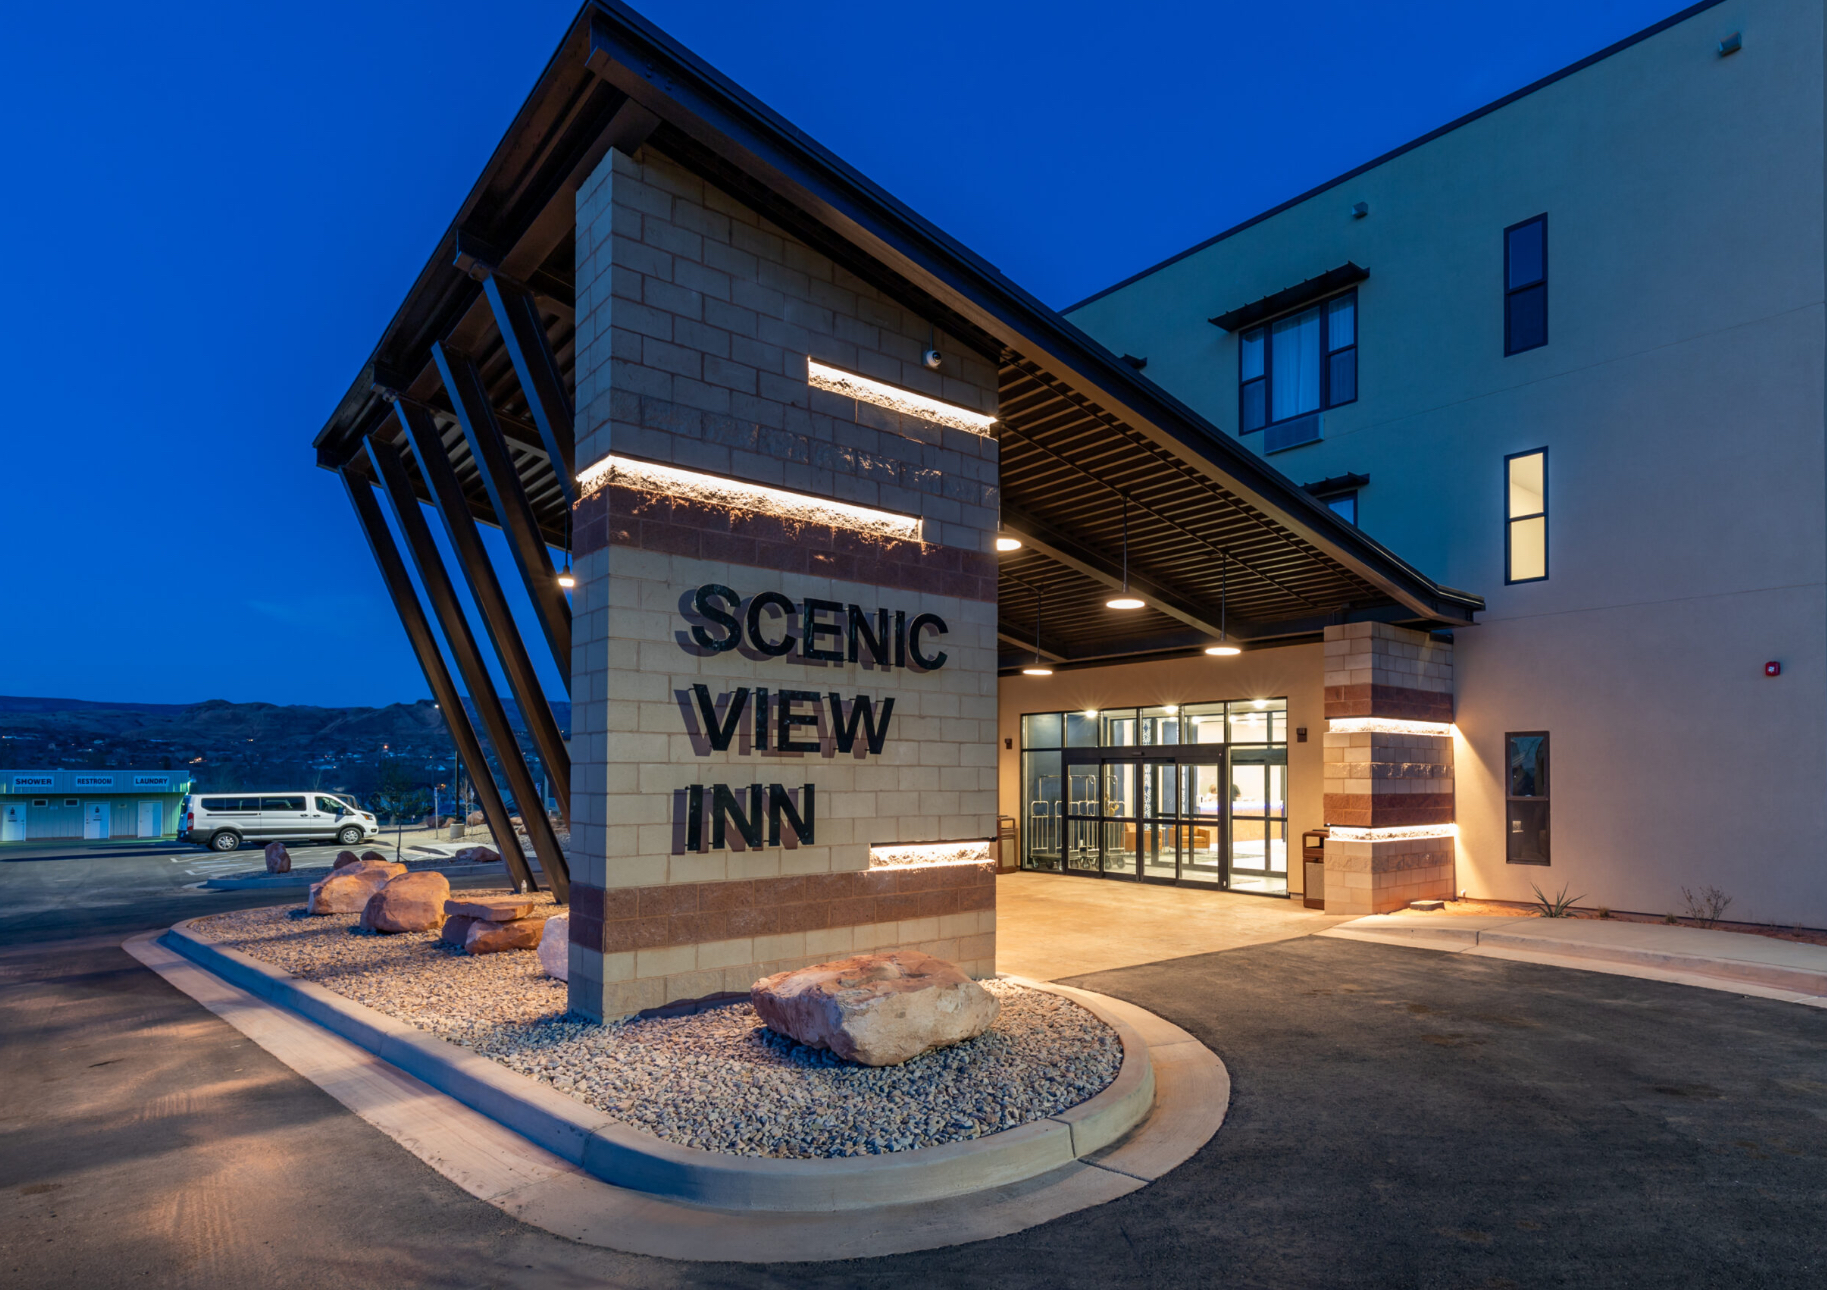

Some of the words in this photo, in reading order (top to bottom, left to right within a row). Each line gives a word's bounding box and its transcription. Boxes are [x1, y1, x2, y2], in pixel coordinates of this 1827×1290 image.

[690, 583, 949, 671] SCENIC
[692, 683, 896, 755] VIEW
[687, 783, 815, 851] INN
